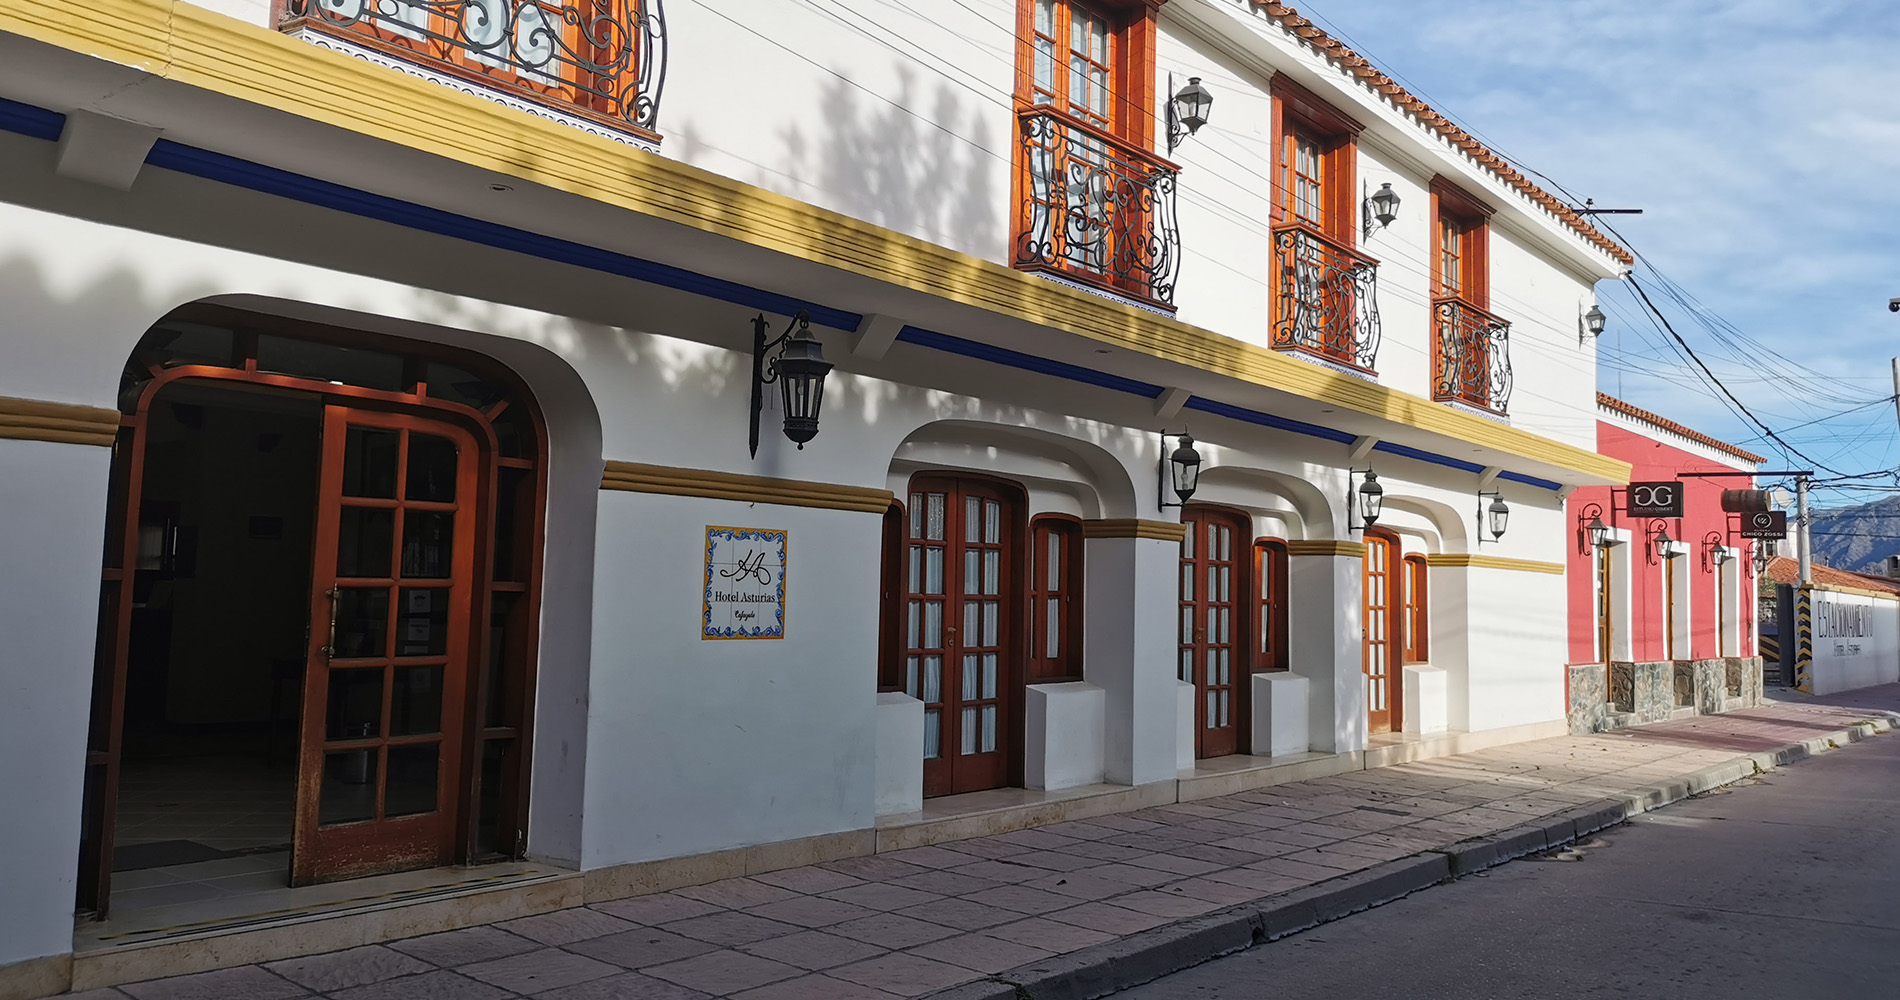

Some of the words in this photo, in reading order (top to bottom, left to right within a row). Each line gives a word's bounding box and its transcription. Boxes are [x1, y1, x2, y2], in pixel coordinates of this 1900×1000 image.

[715, 591, 739, 603] Hotel
[741, 592, 776, 603] Asturias
[1818, 601, 1873, 638] ESTACIONAMIENTO
